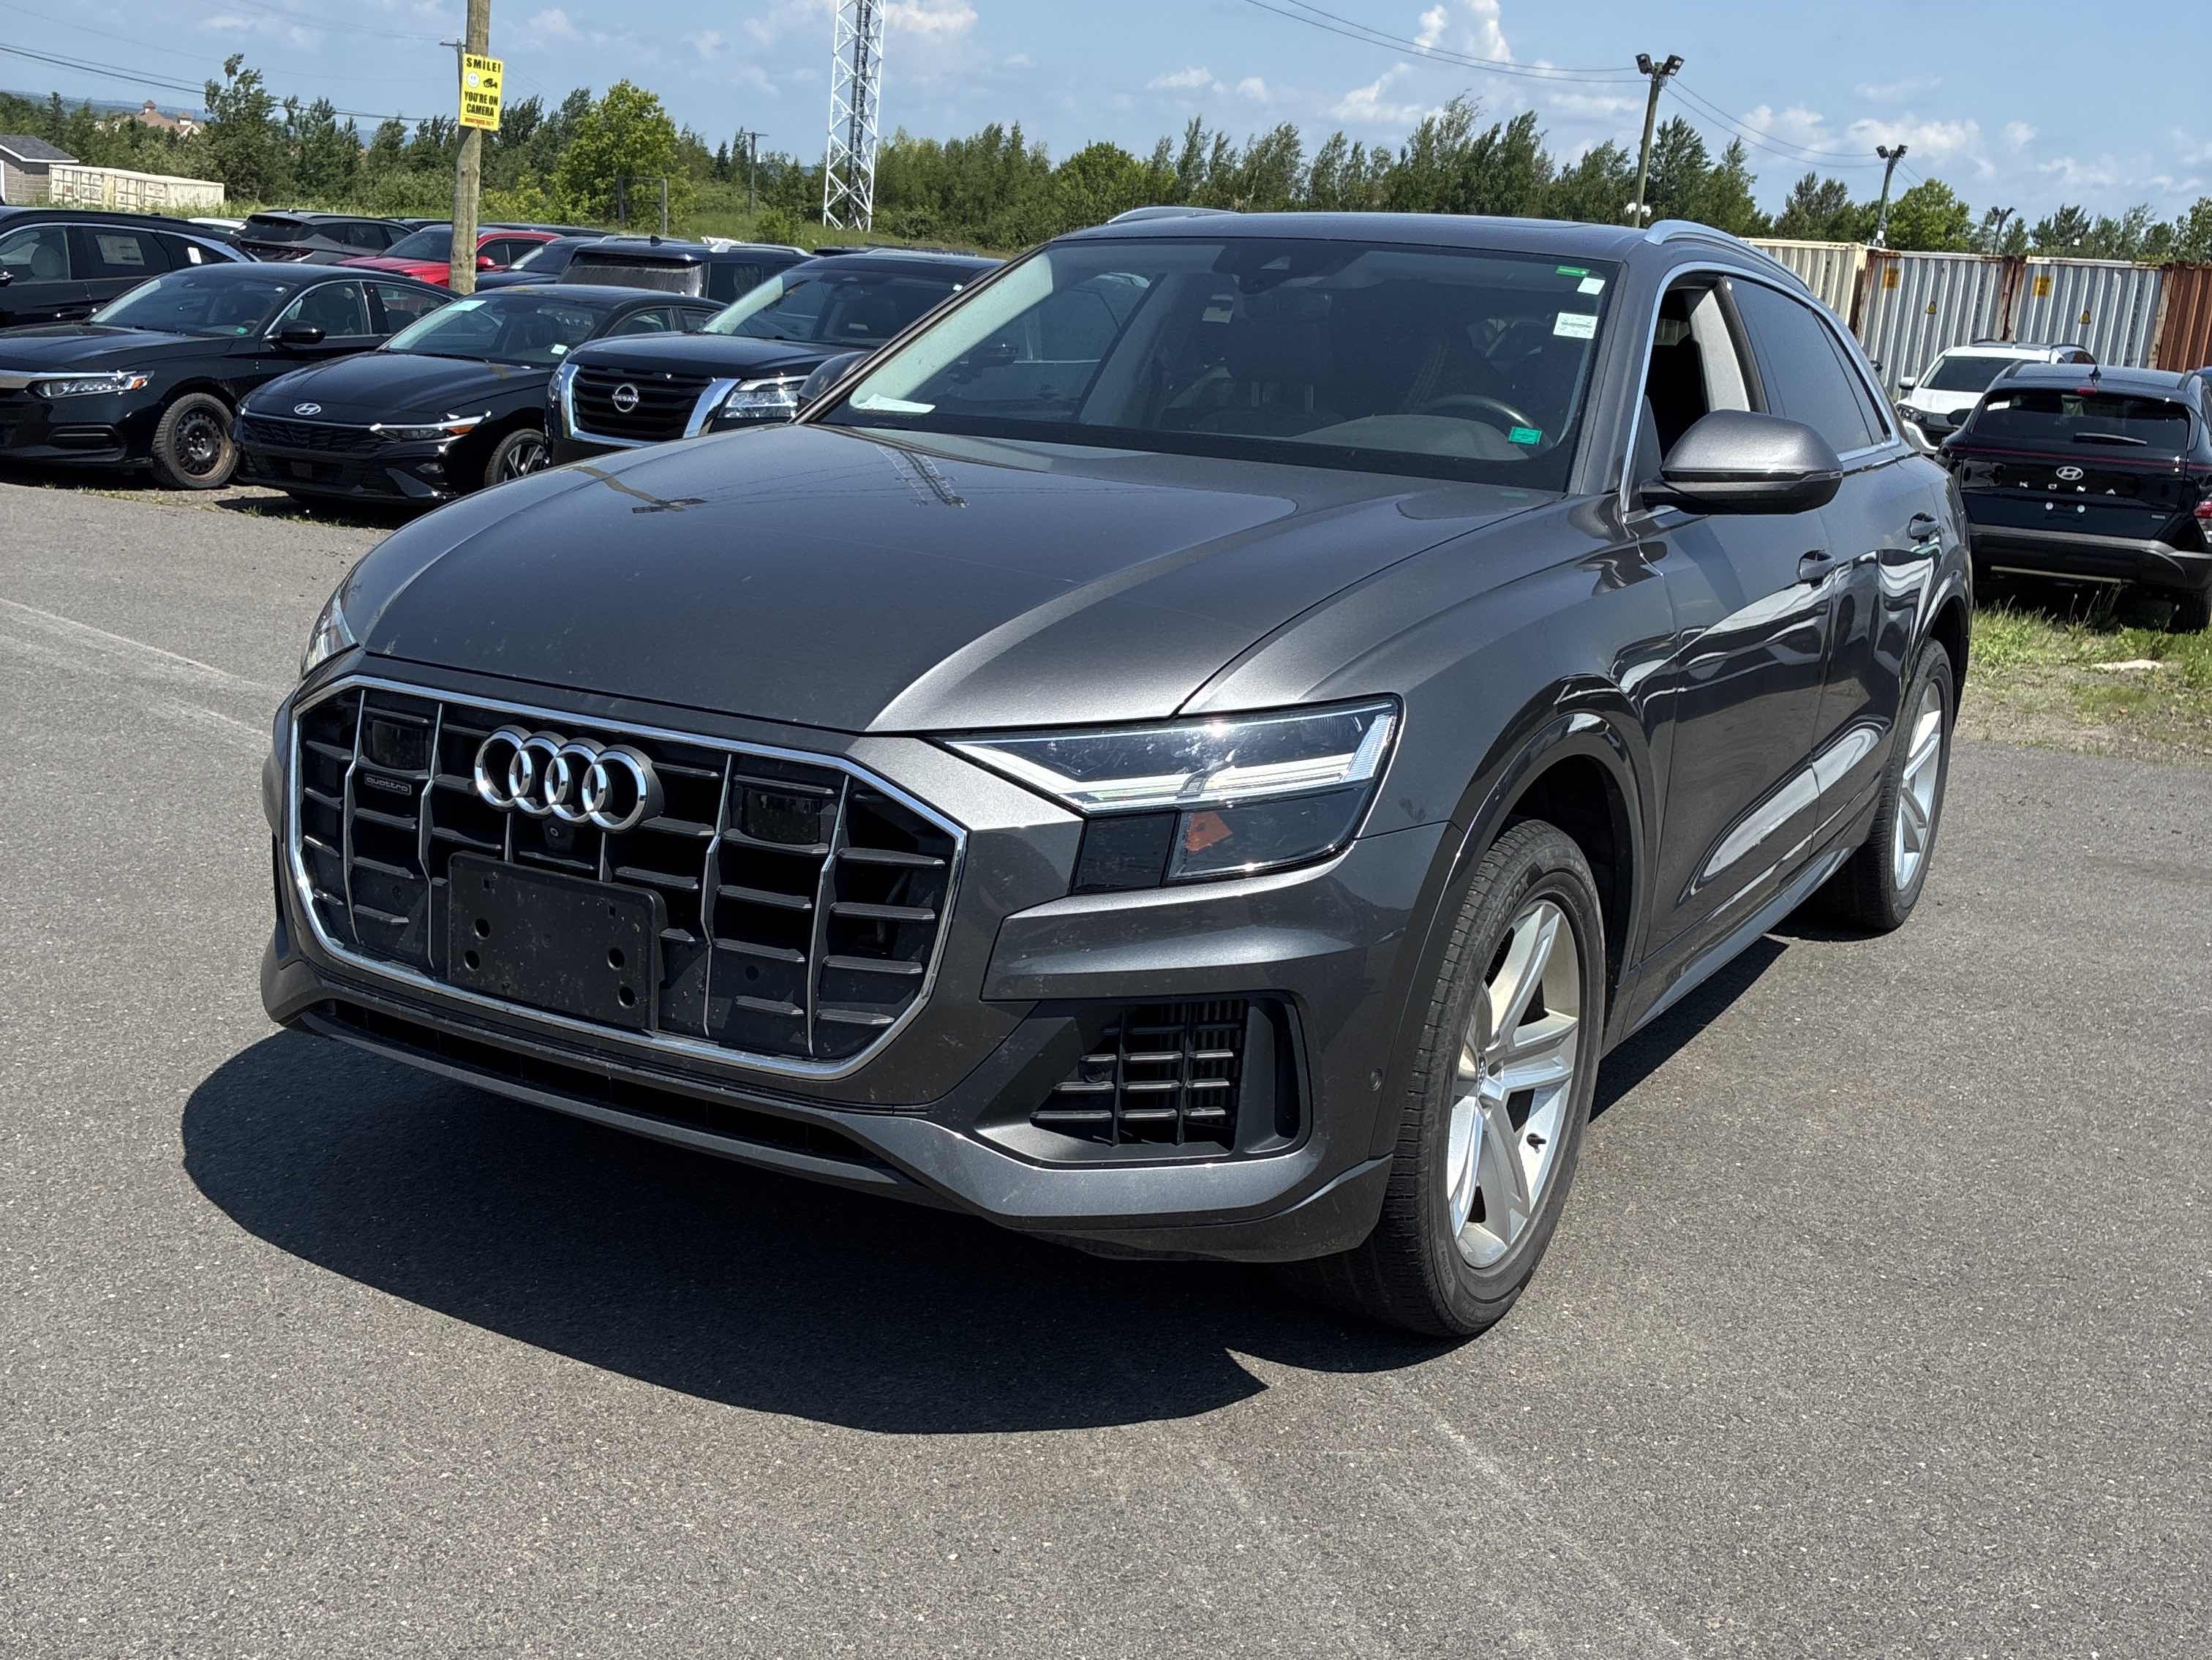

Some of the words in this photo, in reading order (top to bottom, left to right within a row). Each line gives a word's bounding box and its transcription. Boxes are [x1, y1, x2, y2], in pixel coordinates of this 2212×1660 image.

[466, 57, 500, 72] SMILE!
[464, 91, 488, 104] YOU'RE
[489, 95, 499, 106] ON
[466, 102, 494, 117] CAMERA
[2019, 481, 2116, 495] KONA
[366, 777, 409, 792] quattro
